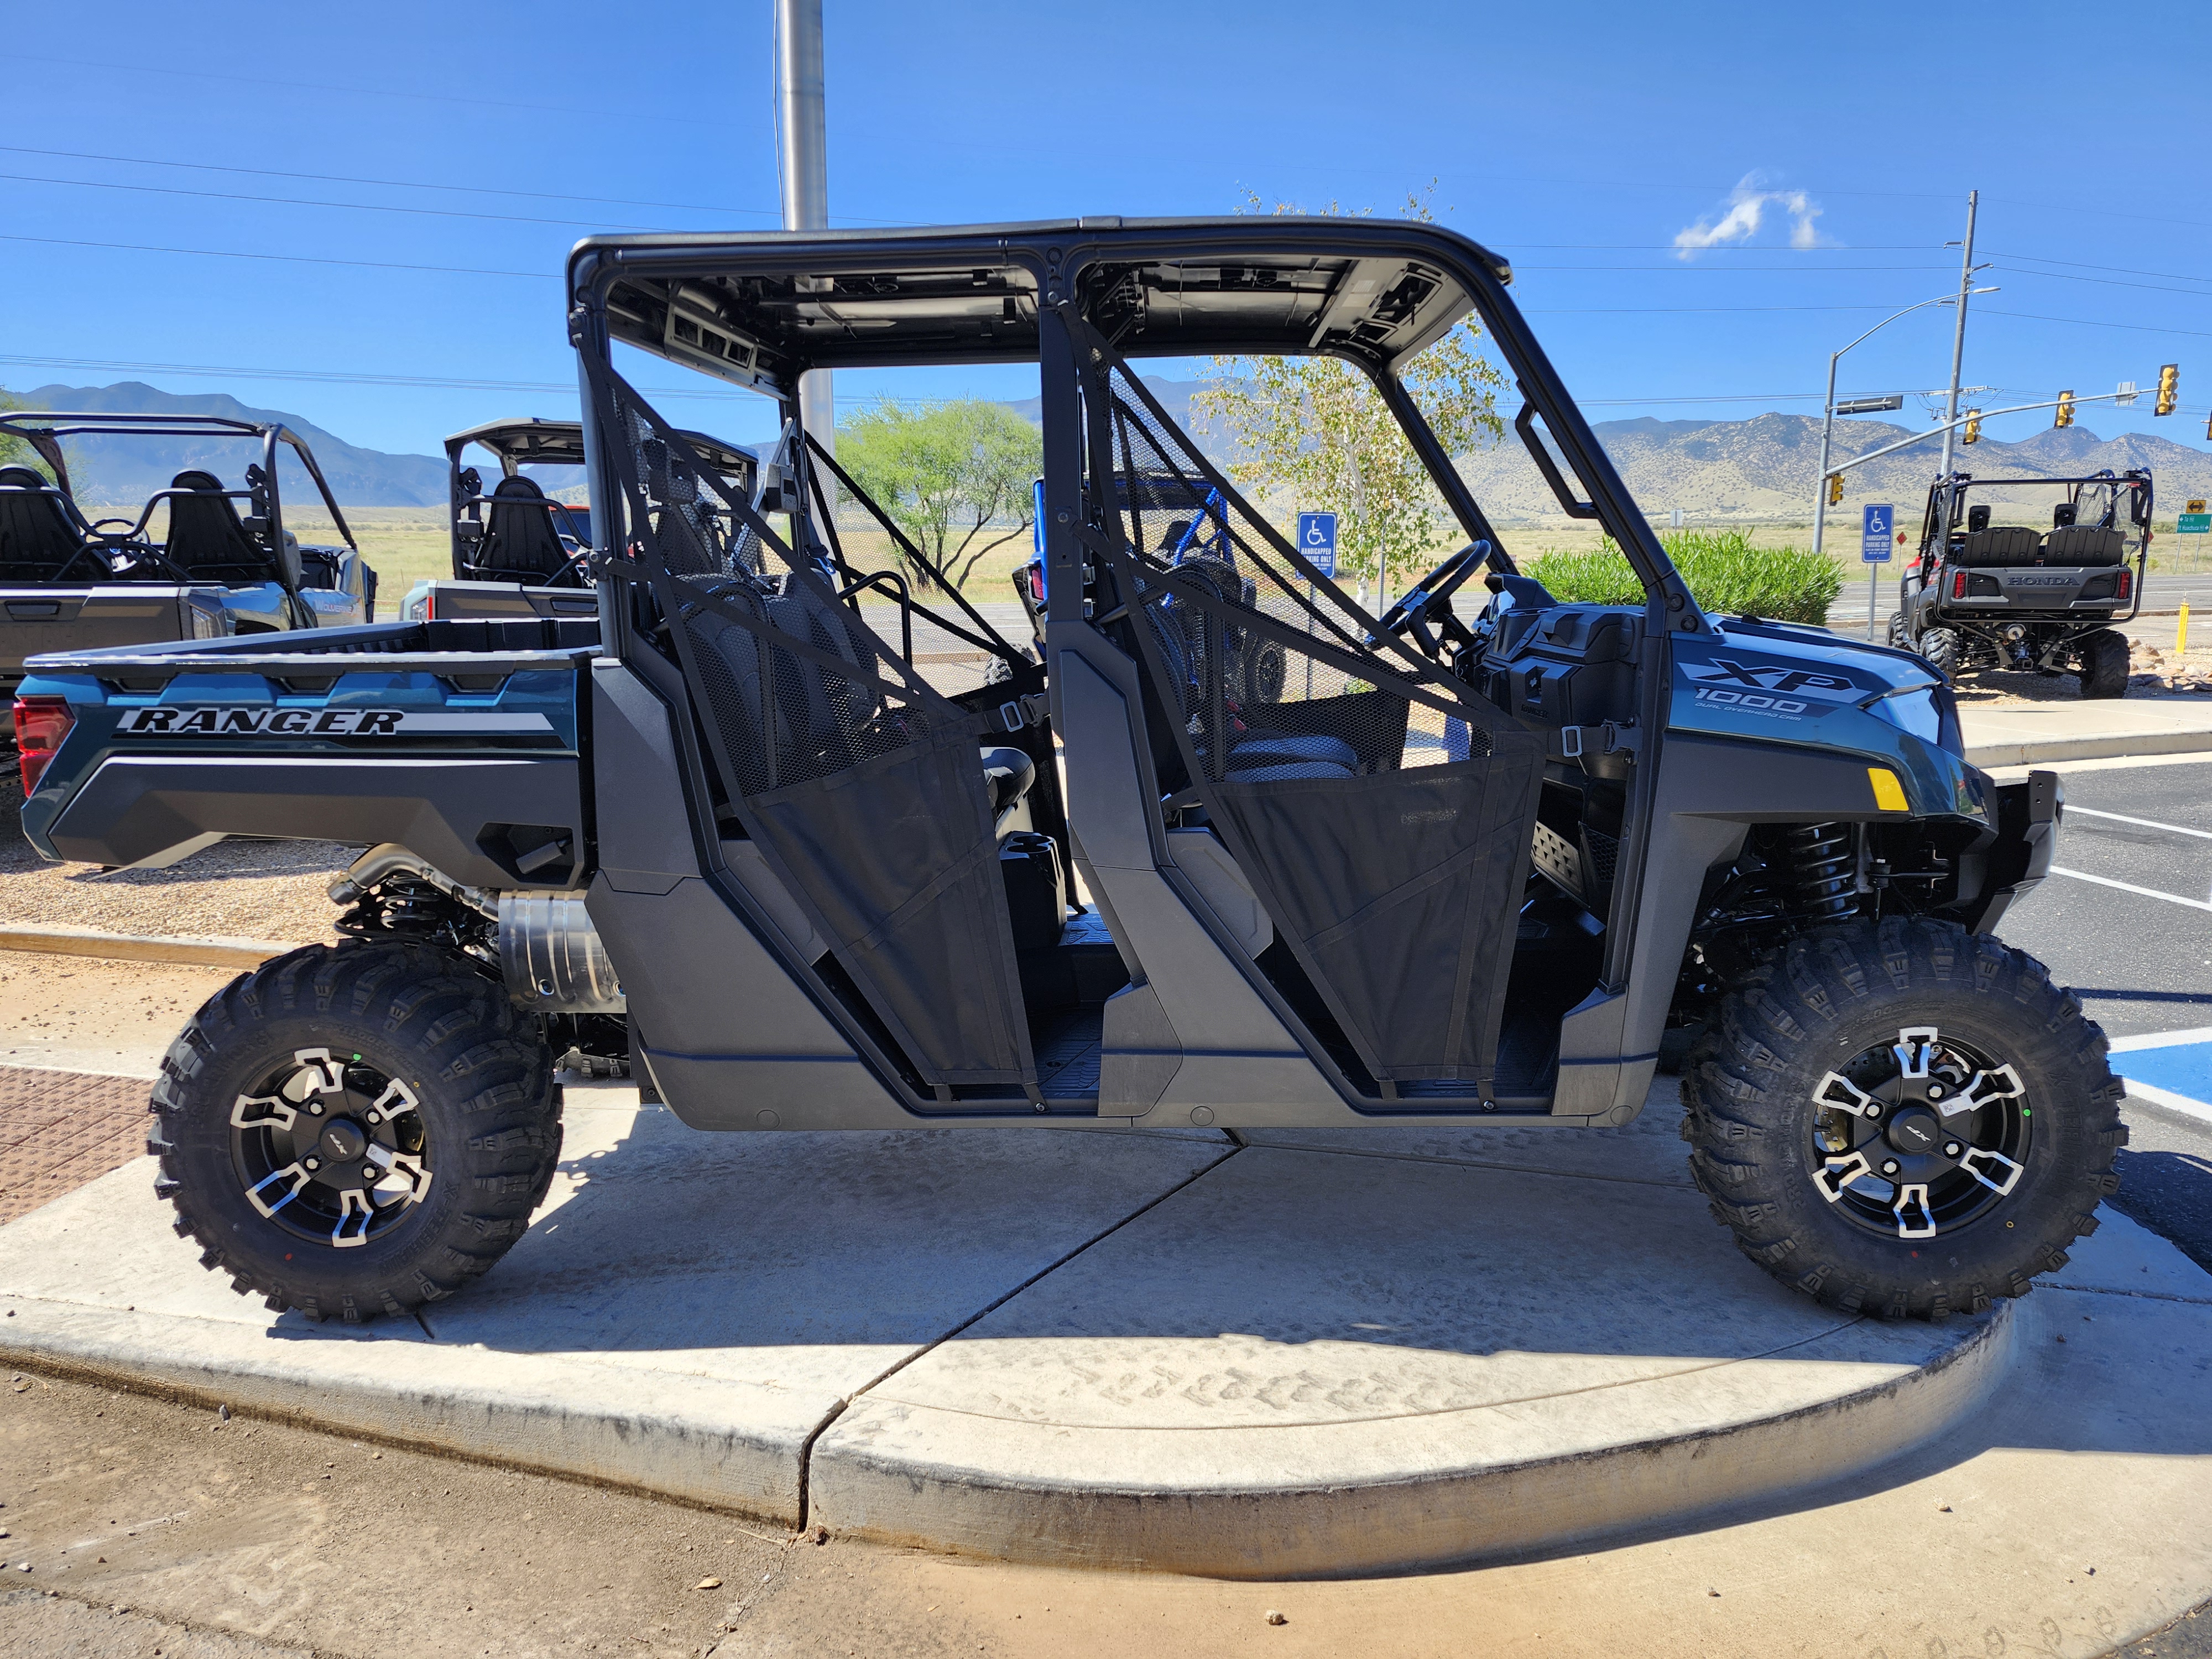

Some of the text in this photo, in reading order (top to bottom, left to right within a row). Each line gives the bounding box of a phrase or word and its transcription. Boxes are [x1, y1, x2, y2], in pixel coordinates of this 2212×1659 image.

[2007, 577, 2080, 586] HONDA
[314, 599, 352, 613] WOLVERINE
[1691, 658, 1857, 692] XP
[1694, 687, 1808, 713] 1000
[1521, 704, 1548, 719] RANGER
[1724, 707, 1778, 718] OVERHEAD
[127, 707, 404, 735] RANGER
